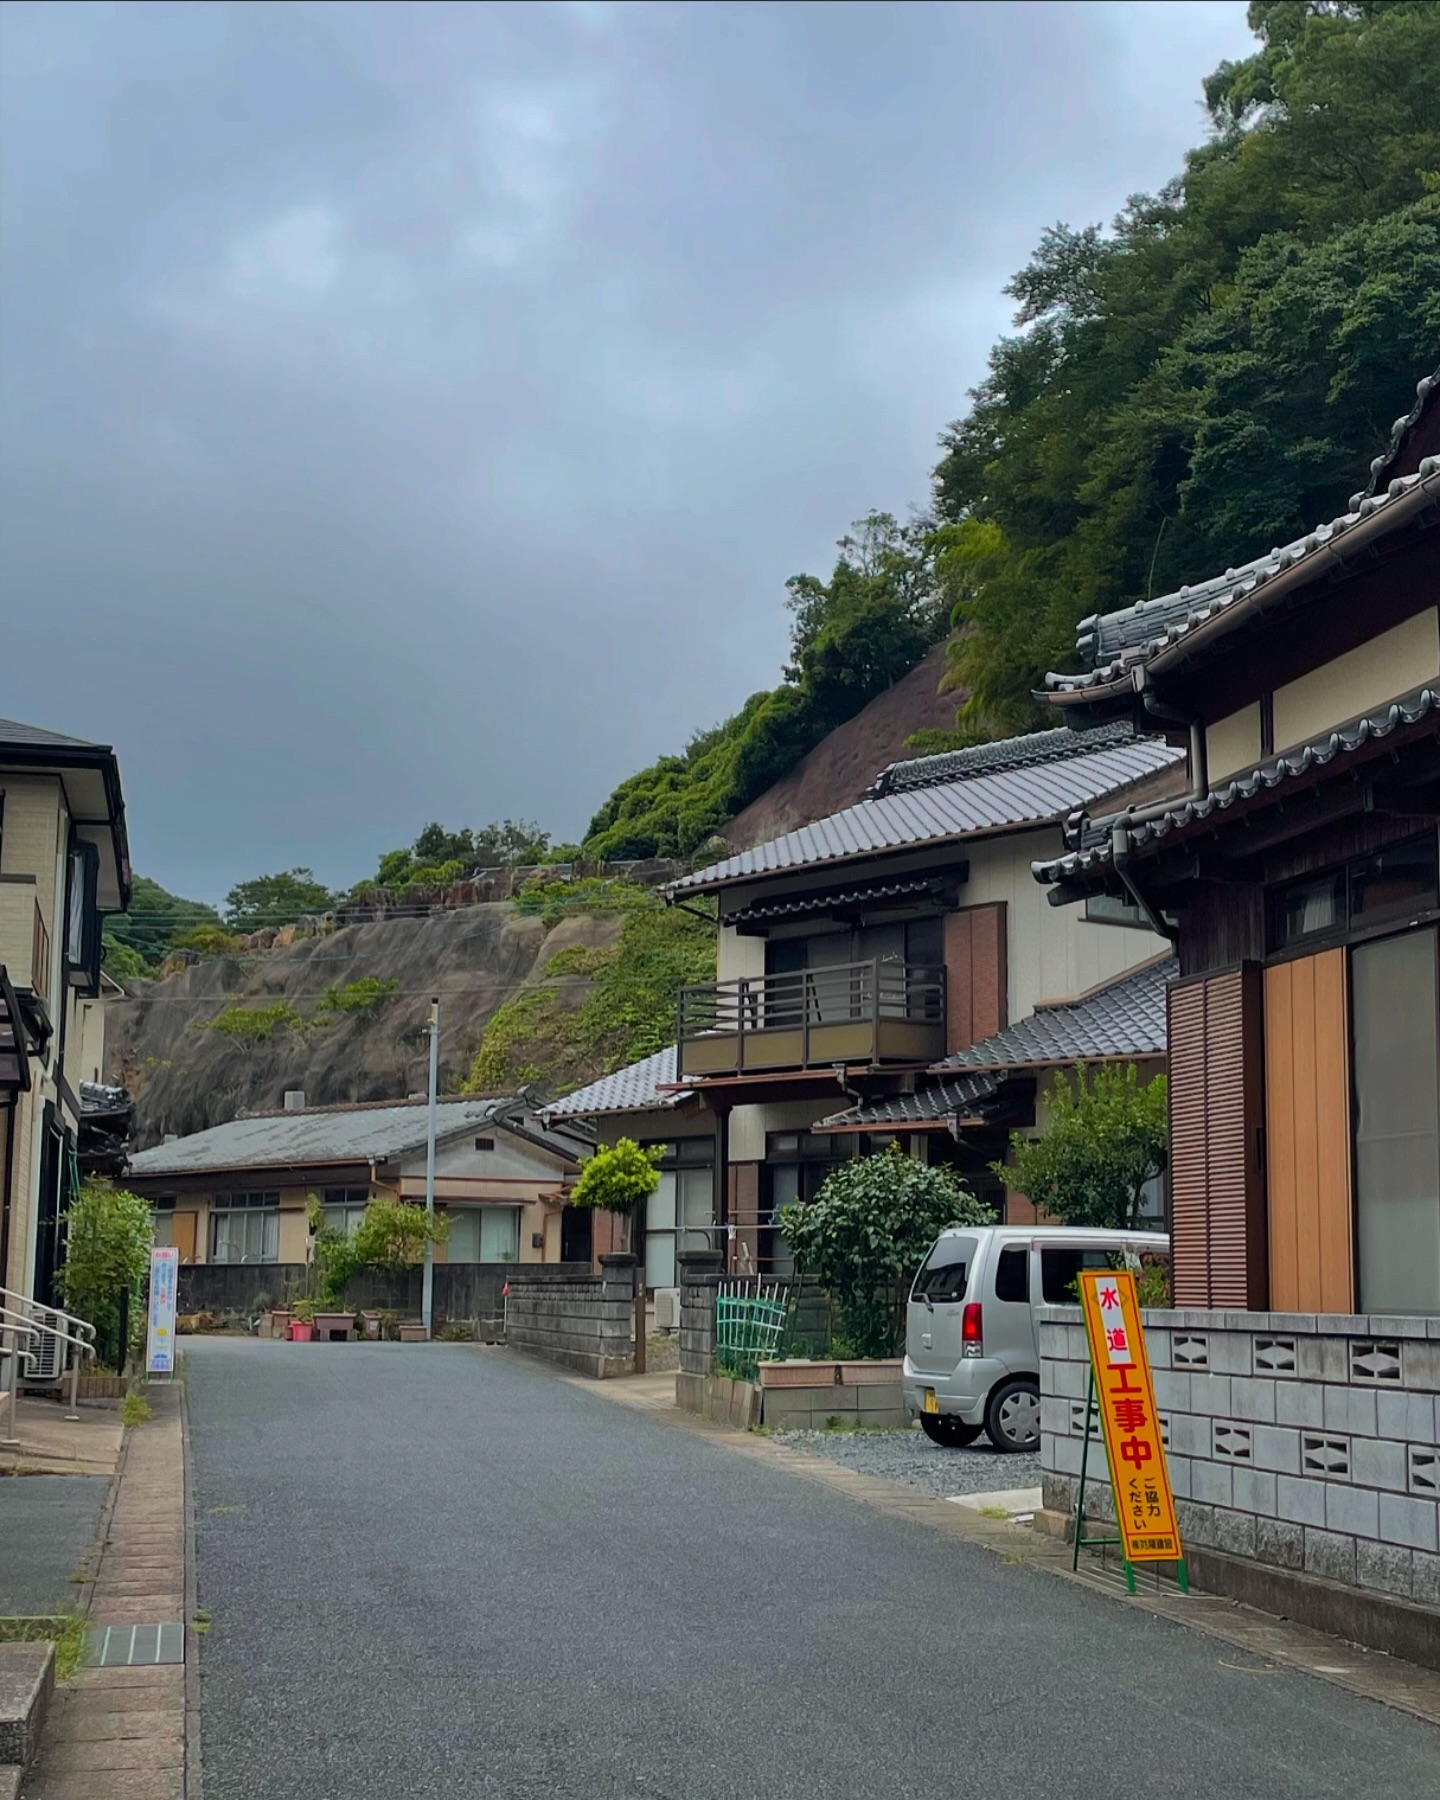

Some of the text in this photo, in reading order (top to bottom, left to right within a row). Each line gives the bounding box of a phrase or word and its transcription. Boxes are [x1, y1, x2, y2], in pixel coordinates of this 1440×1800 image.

[1129, 1478, 1147, 1530] ください
[1144, 1477, 1161, 1517] ご協力
